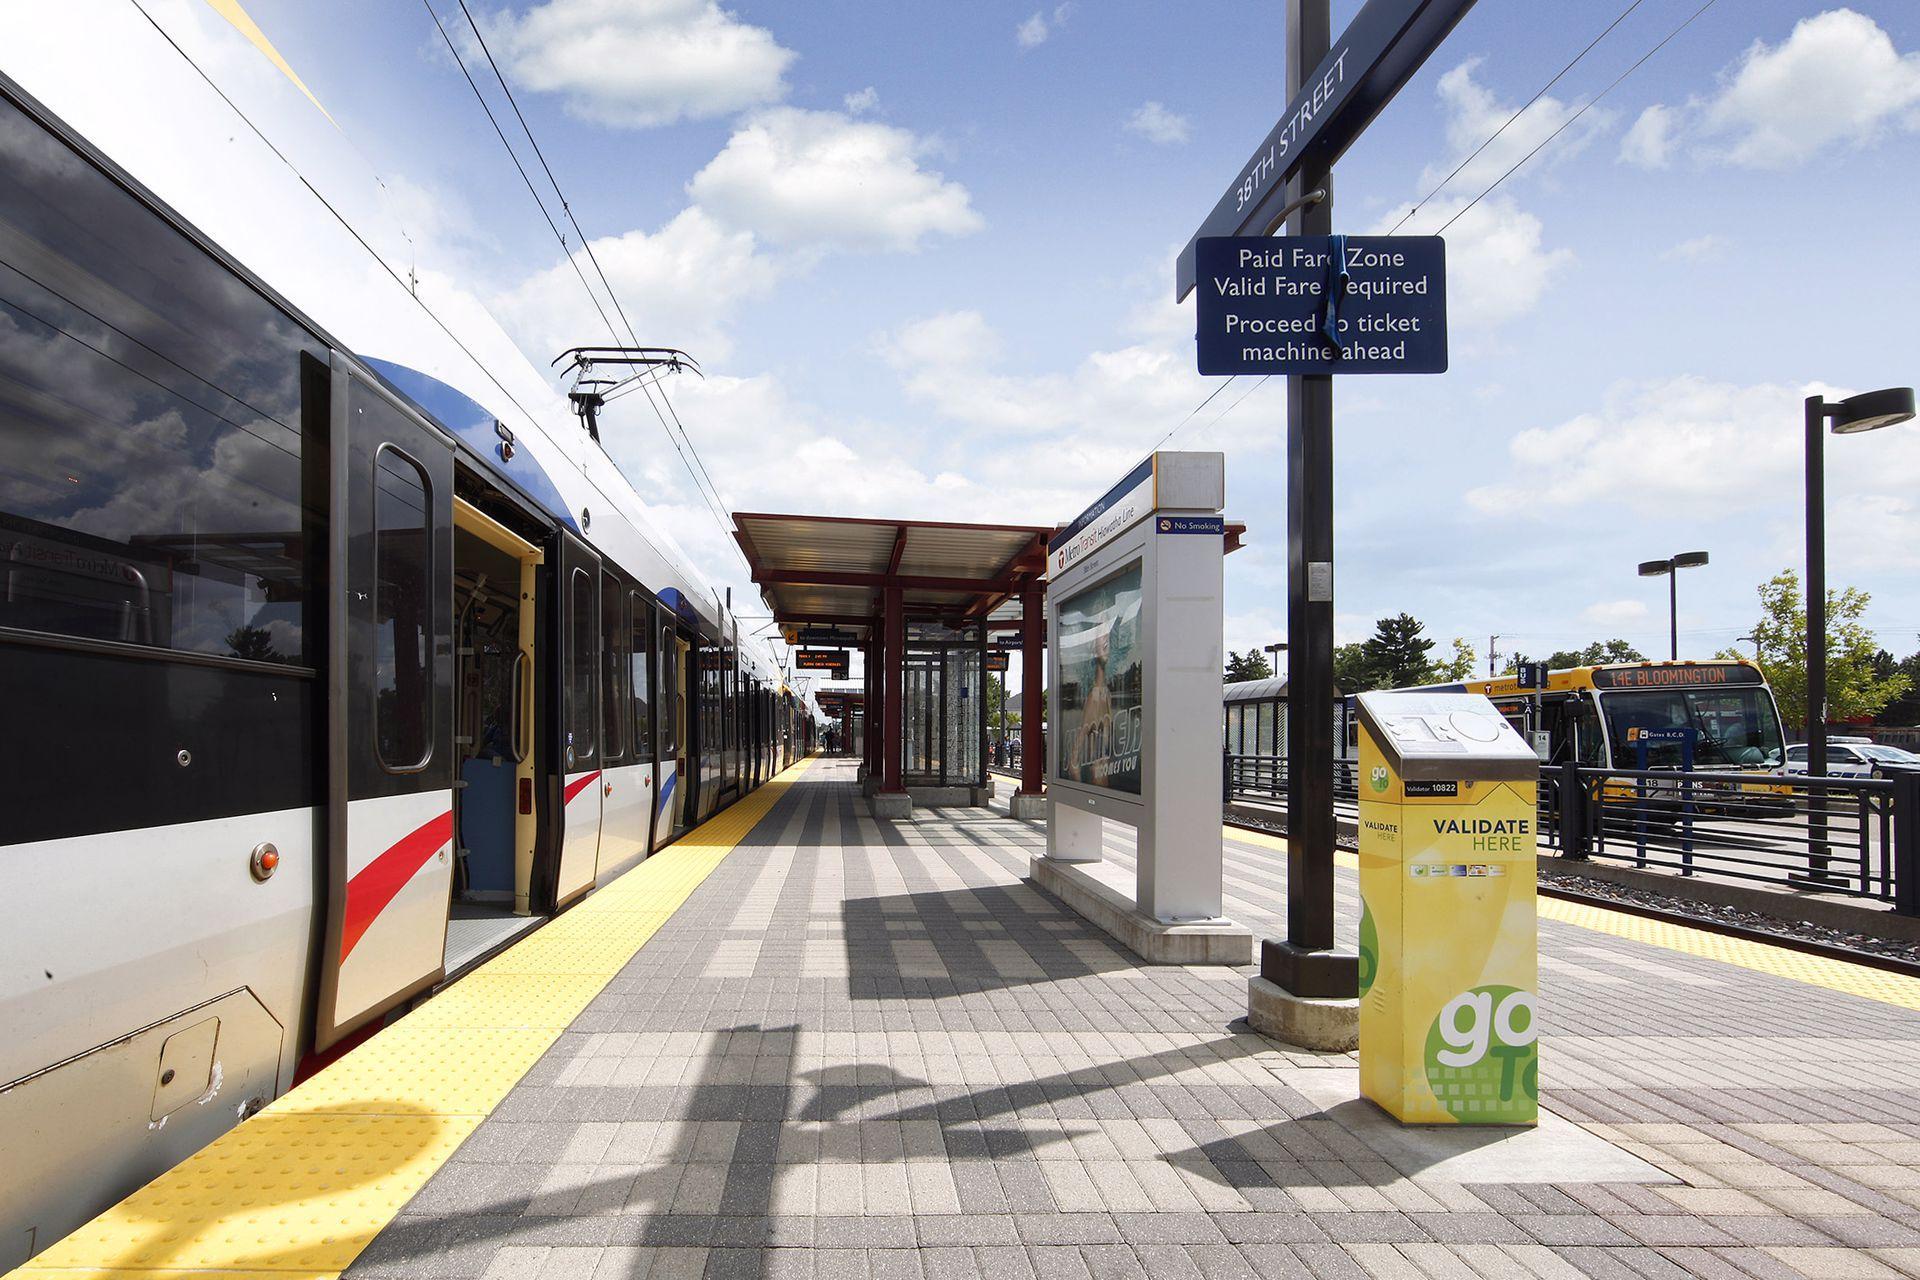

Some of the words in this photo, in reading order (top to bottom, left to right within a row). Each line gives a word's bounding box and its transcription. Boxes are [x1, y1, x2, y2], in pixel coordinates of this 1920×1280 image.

[1236, 145, 1274, 212] 38TH
[1279, 47, 1349, 157] STREET
[1239, 249, 1283, 268] Paid
[1347, 247, 1405, 267] Zone
[1214, 276, 1266, 296] Valid
[1275, 276, 1322, 296] Fare
[1346, 275, 1427, 300] equired
[1226, 314, 1317, 333] Proceed
[1357, 313, 1421, 332] ticket
[1242, 342, 1333, 360] machine
[1342, 341, 1405, 360] ahead
[1064, 544, 1080, 564] Metro
[1080, 527, 1098, 552] Transit
[1122, 506, 1135, 523] Line
[1174, 522, 1187, 530] No
[1189, 521, 1220, 532] Smoking
[1637, 667, 1726, 686] BLOOMINGTON
[1371, 767, 1387, 781] go
[1432, 783, 1456, 792] 10822
[1364, 820, 1398, 833] VALIDATE
[1433, 819, 1529, 834] VALIDATE
[1377, 832, 1396, 842] HERE
[1473, 836, 1522, 851] HERE
[1436, 991, 1538, 1068] go
